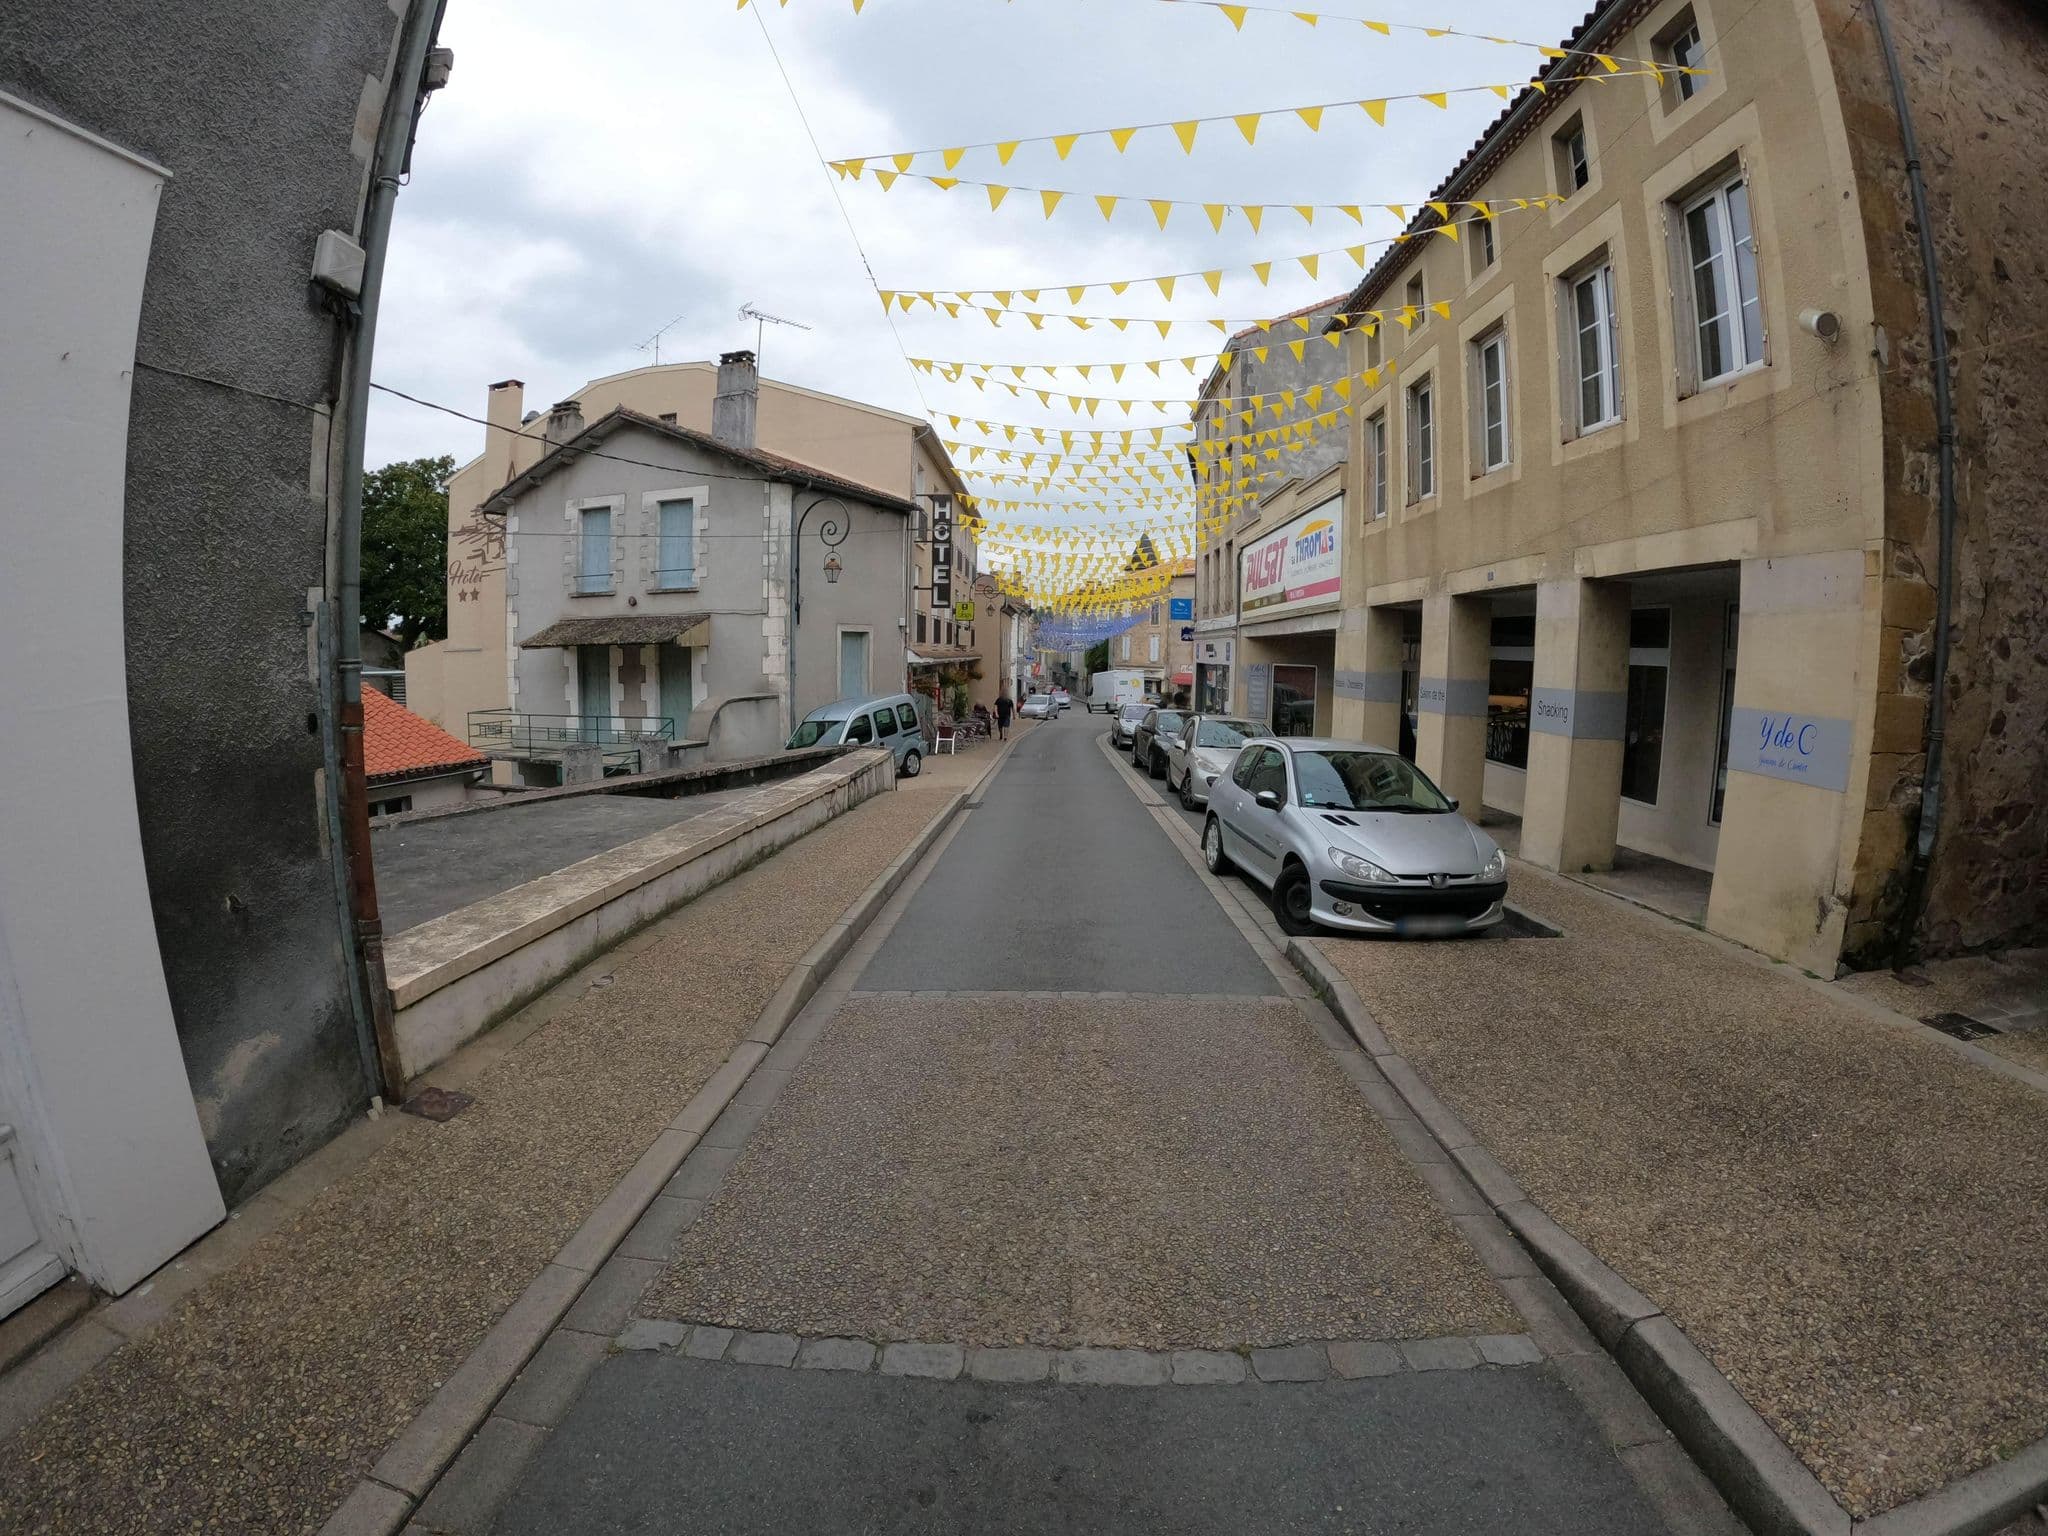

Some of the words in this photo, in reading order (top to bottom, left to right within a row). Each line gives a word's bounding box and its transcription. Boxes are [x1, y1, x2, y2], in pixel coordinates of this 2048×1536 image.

[933, 500, 951, 606] HOTEL
[1245, 536, 1288, 593] PULSAT
[1537, 700, 1568, 724] Snacking
[1773, 716, 1796, 749] de
[1798, 723, 1818, 755] C
